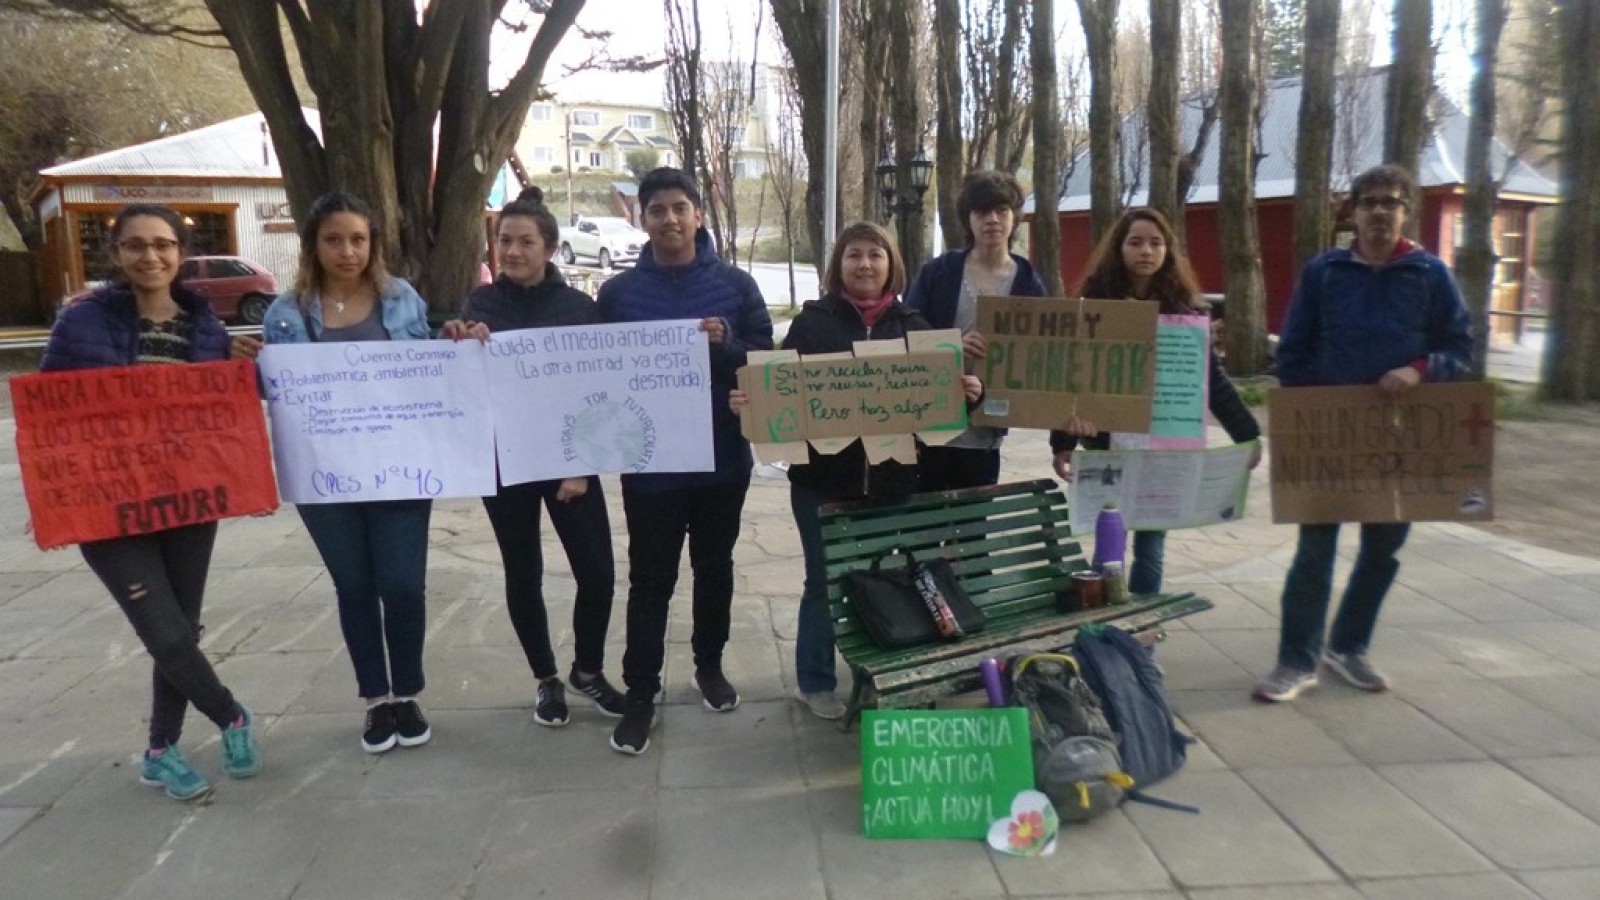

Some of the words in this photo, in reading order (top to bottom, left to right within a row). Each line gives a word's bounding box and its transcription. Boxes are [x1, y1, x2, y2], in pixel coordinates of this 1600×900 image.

[993, 310, 1031, 336] NO
[1038, 311, 1102, 339] HAY
[344, 344, 402, 366] Cuenta
[489, 336, 537, 357] Cuida
[543, 333, 558, 352] el
[372, 363, 443, 382] ambiental
[542, 361, 572, 376] otra
[576, 354, 623, 373] mitad
[630, 354, 650, 369] ya
[654, 347, 690, 369] está
[775, 363, 798, 381] Si
[803, 367, 823, 378] no
[24, 378, 89, 414] MIRA
[97, 378, 111, 402] A
[112, 372, 158, 399] TUS
[234, 364, 249, 395] A
[284, 388, 333, 405] Evitar
[775, 381, 798, 396] Si
[806, 382, 825, 391] no
[808, 397, 852, 420] Pero
[893, 399, 934, 421] algo
[31, 418, 71, 449] LOS
[139, 407, 150, 433] Y
[402, 466, 443, 496] 46
[116, 485, 229, 536] FUTURO
[873, 715, 1013, 748] EMERGENCIA
[872, 750, 996, 786] CLIMÁTICA
